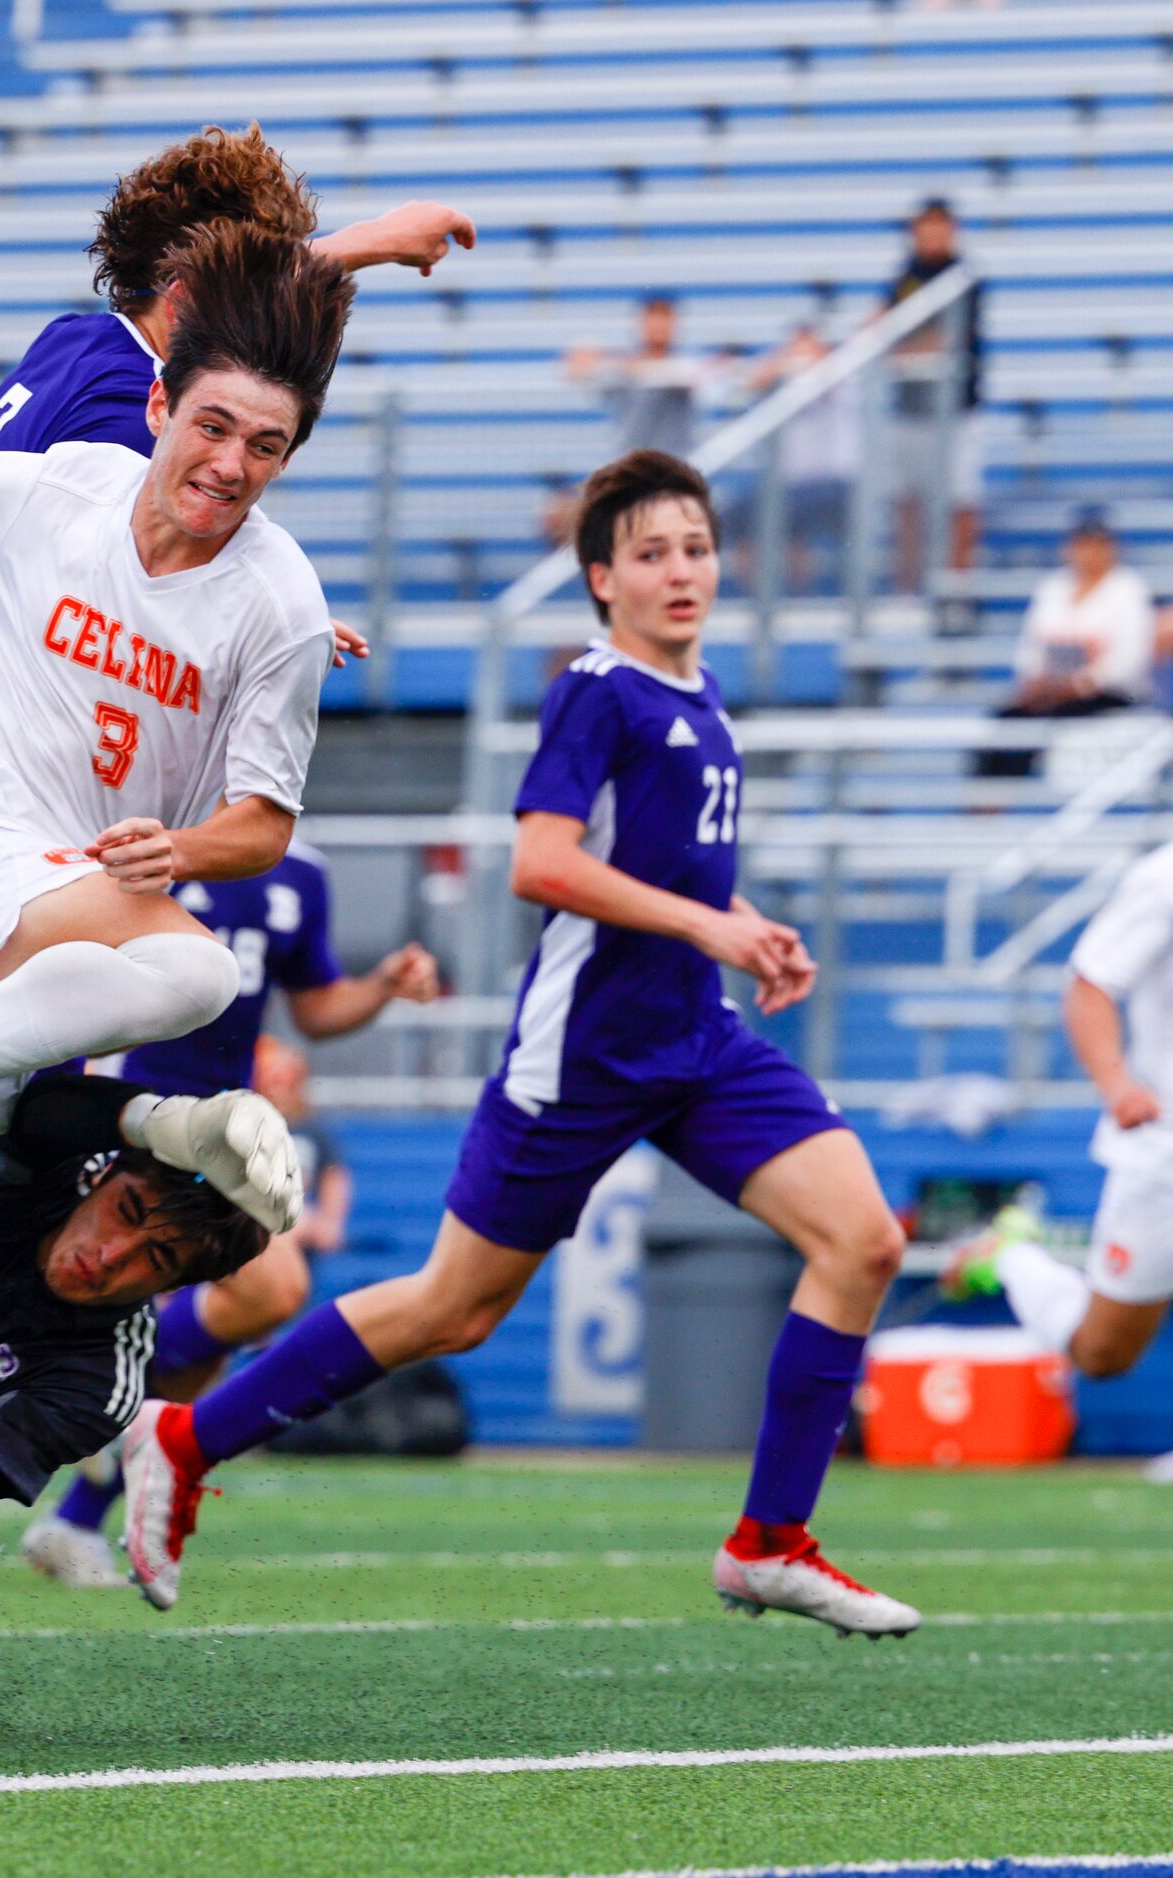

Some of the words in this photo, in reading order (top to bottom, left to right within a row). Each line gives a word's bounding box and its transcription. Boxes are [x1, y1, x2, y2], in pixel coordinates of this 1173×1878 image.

[43, 594, 202, 715] CELINA
[92, 701, 140, 790] 3
[695, 764, 739, 844] 21
